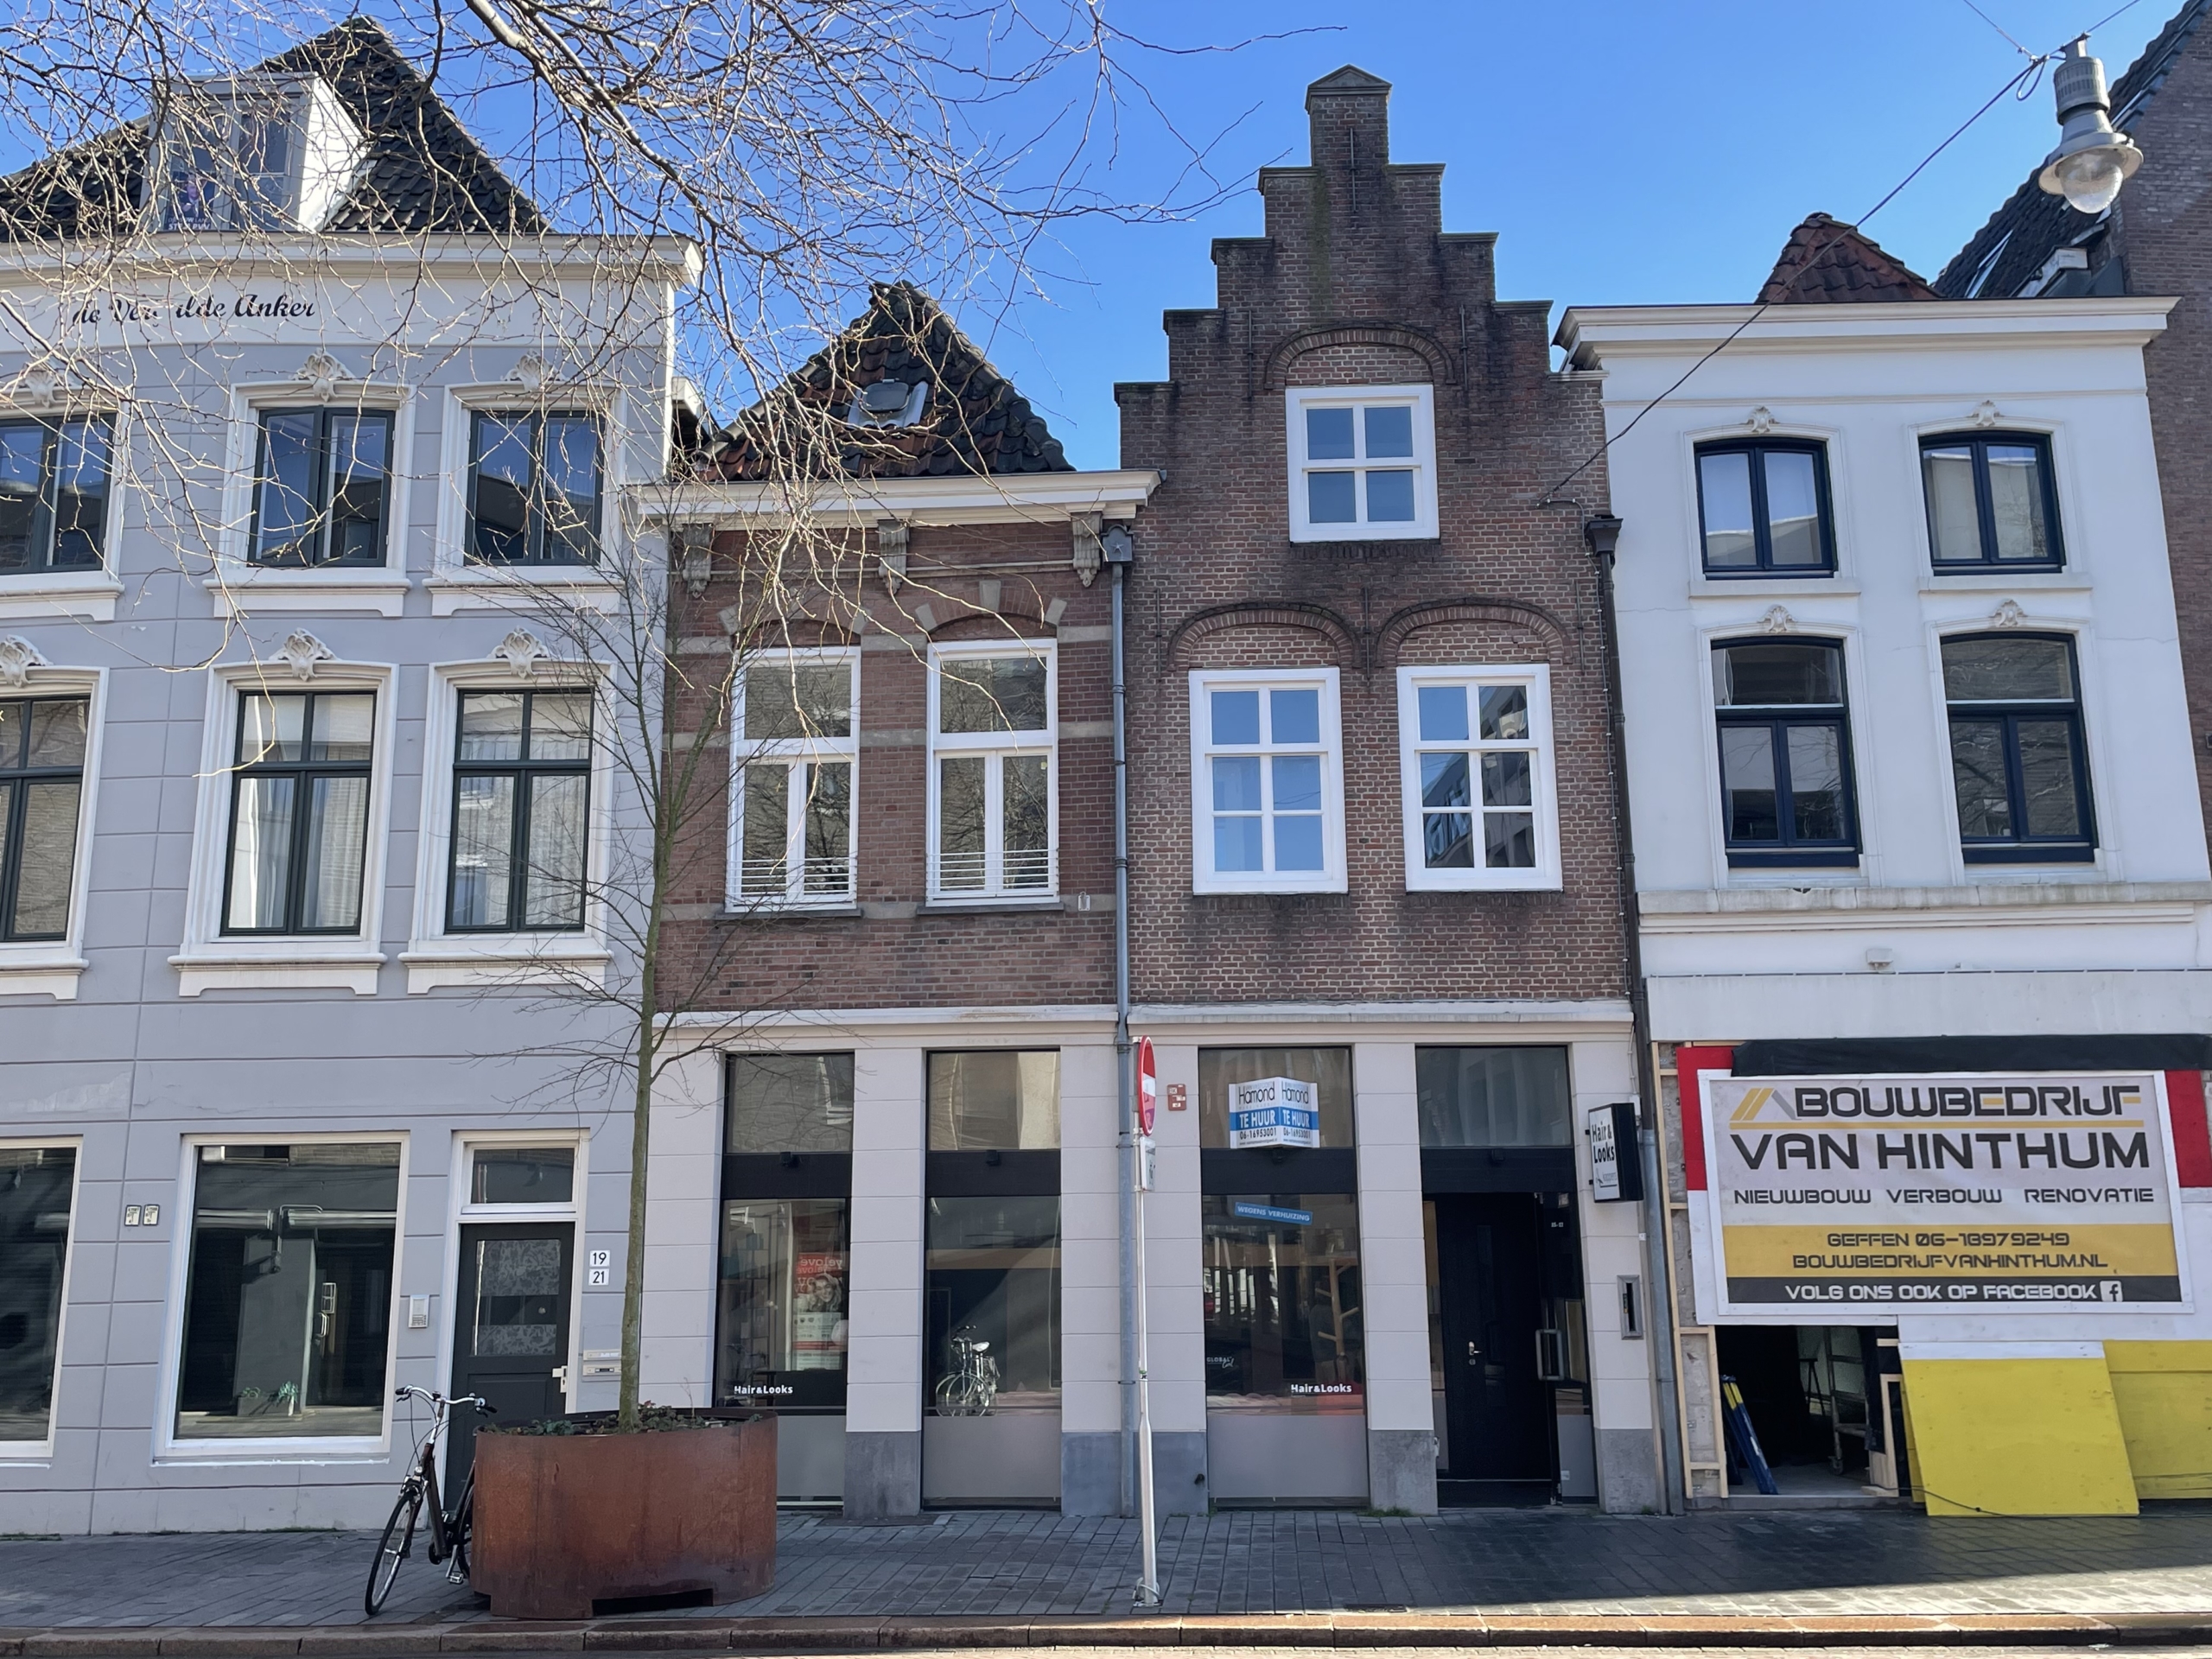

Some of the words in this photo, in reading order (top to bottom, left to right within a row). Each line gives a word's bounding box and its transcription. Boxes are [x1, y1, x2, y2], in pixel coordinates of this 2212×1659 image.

[109, 295, 226, 327] Verlde
[234, 294, 315, 317] Anker
[1238, 1081, 1275, 1105] Hamond
[1281, 1081, 1309, 1104] Hamond
[1794, 1085, 2142, 1117] BOUWBEDRIJF
[1239, 1112, 1249, 1128] TE
[1250, 1109, 1276, 1128] HUUR
[1282, 1109, 1291, 1125] TE
[1292, 1111, 1310, 1128] HUUR
[1591, 1121, 1607, 1142] Hair
[1592, 1141, 1615, 1164] Looks
[1730, 1133, 1859, 1170] VAN
[1876, 1132, 2150, 1169] HINTHUM
[1733, 1189, 1872, 1205] NIEUWBOUW
[1886, 1188, 2003, 1204] VERBOUW
[2024, 1187, 2154, 1203] RENOVATIE
[1237, 1205, 1267, 1216] WEGENS
[1268, 1210, 1311, 1222] VERHUIZING
[1827, 1232, 1910, 1247] GEFFEN
[593, 1252, 607, 1265] 19
[1792, 1254, 2108, 1268] BOUWBEDRIJFVANHINTHUM.NL
[593, 1270, 605, 1284] 21
[1784, 1285, 1844, 1300] VOLG
[1848, 1285, 1893, 1300] ONS
[1897, 1285, 1943, 1300] OOK
[1947, 1284, 1978, 1300] OP
[1982, 1284, 2097, 1300] FACEBOOK
[734, 1384, 793, 1395] Hair&Looks
[1291, 1383, 1352, 1393] Hair&Looks
